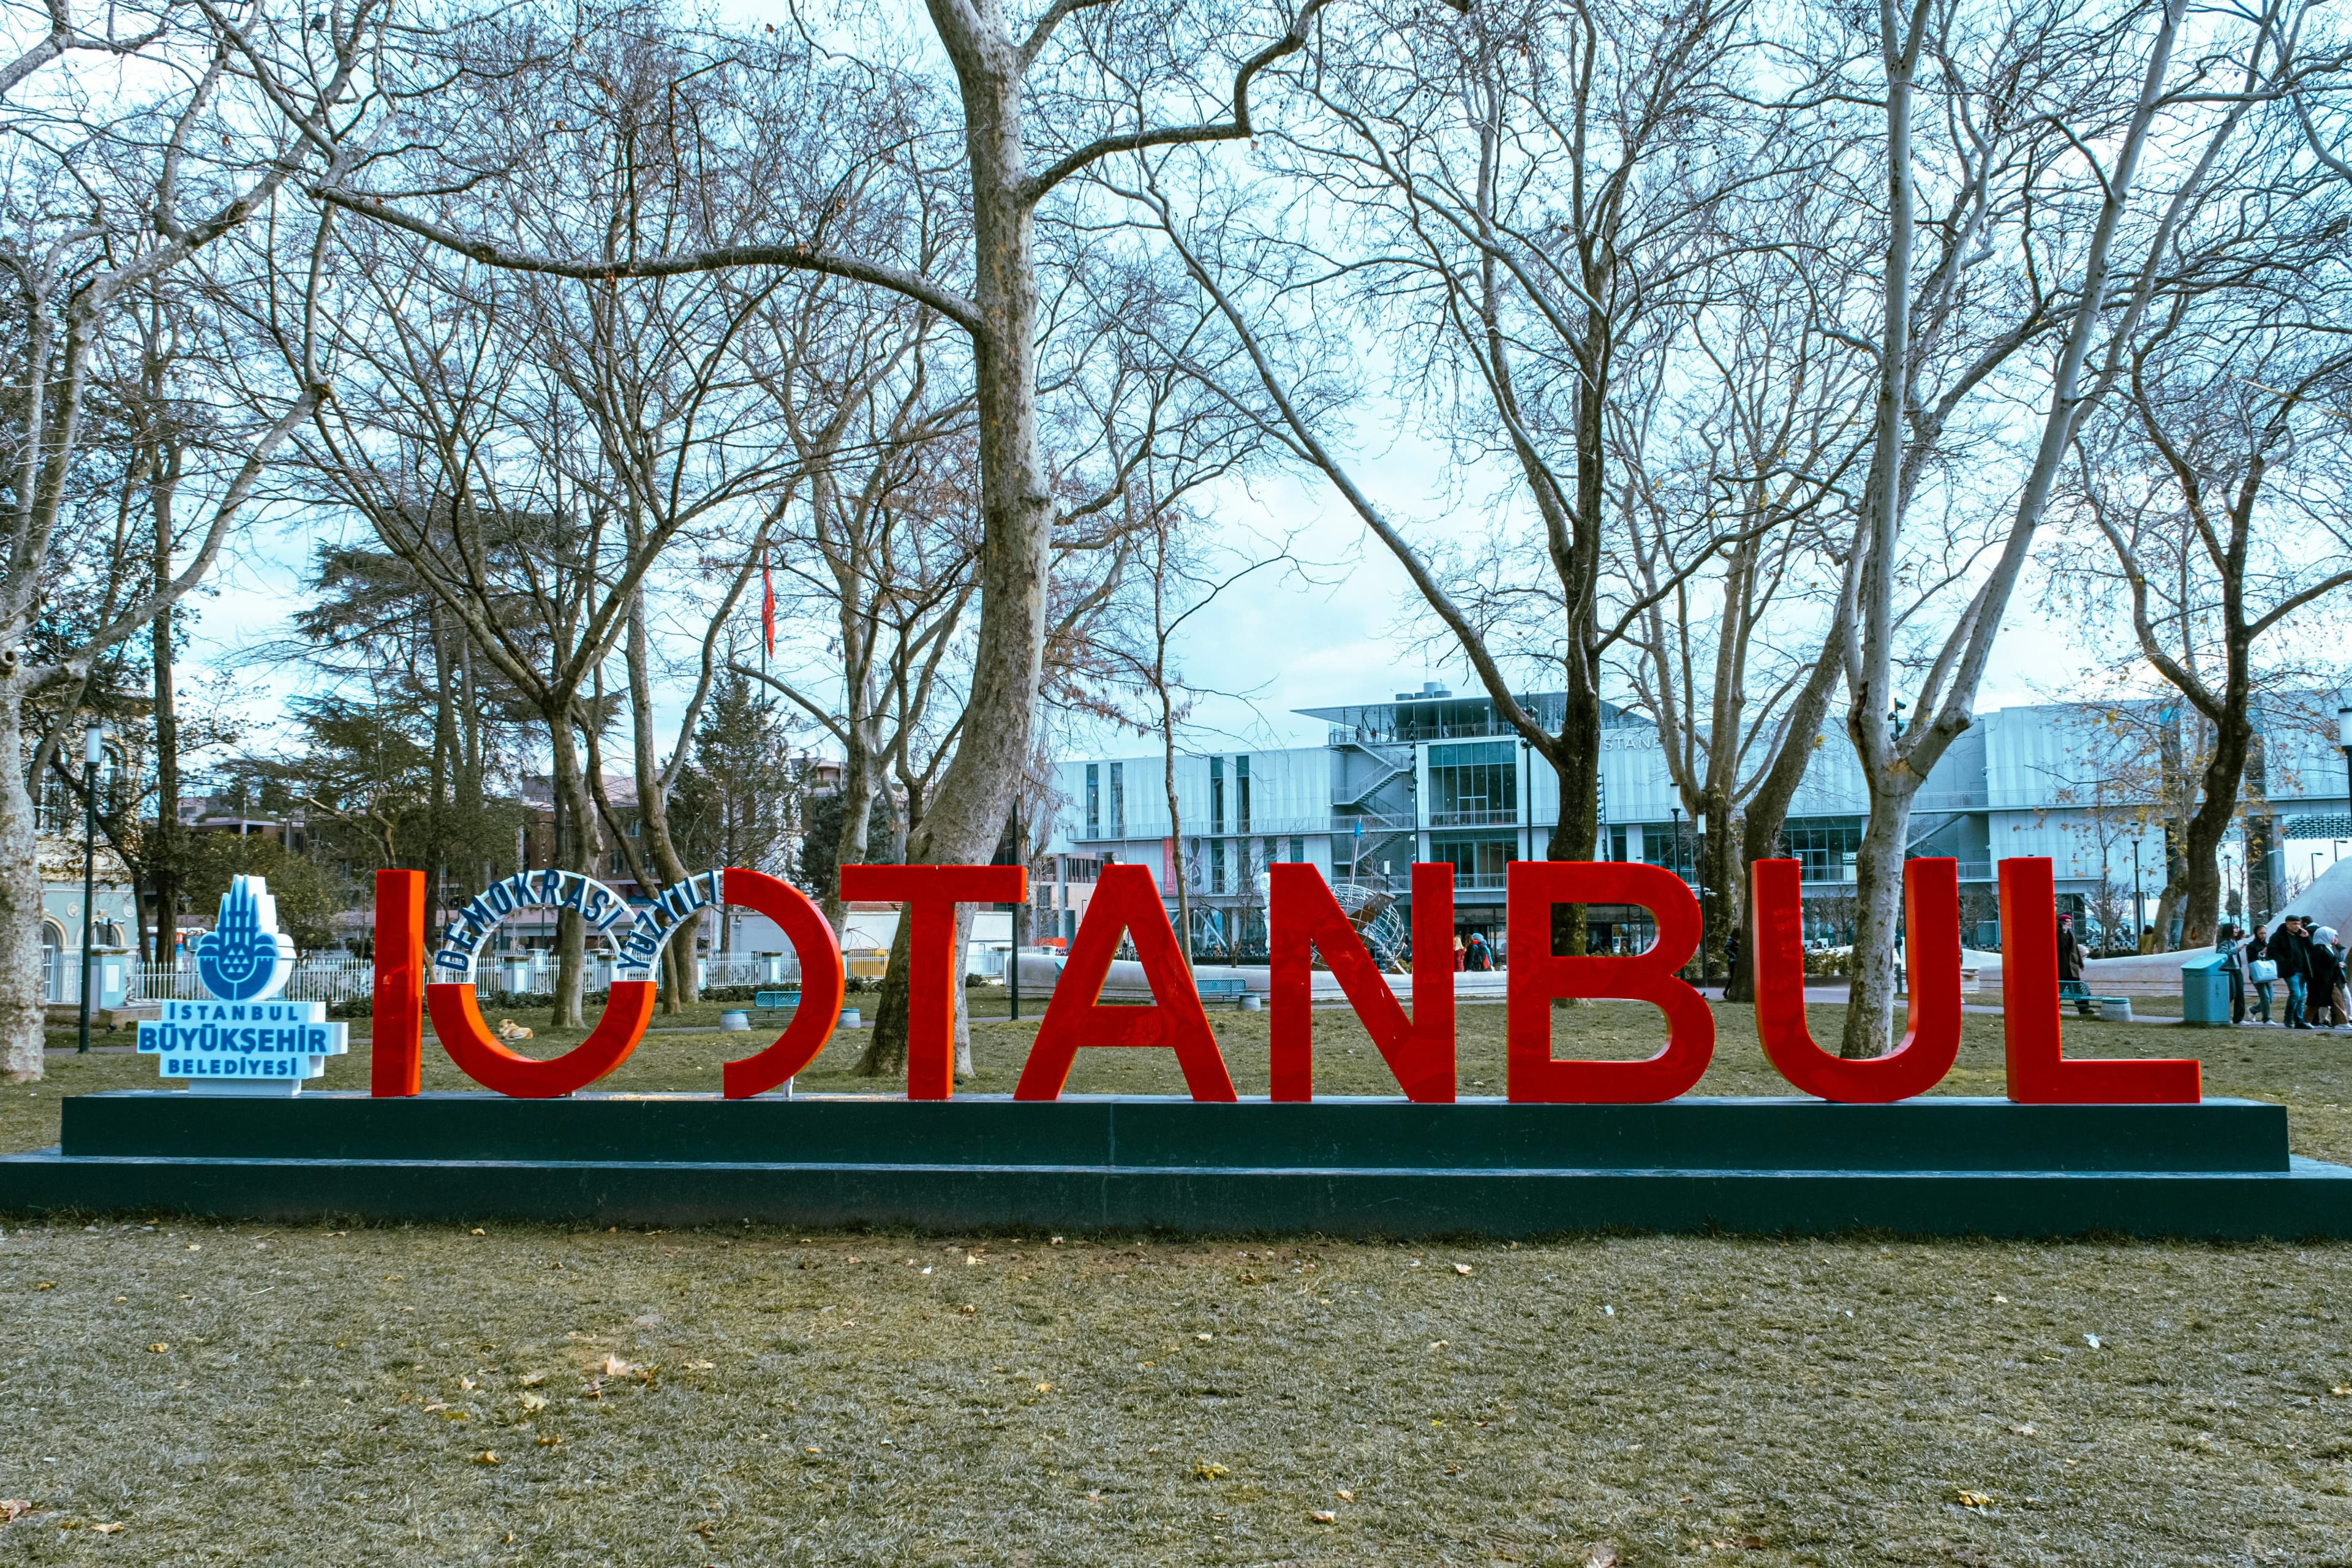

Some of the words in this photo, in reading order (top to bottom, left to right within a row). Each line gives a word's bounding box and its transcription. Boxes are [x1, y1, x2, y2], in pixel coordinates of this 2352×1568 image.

[170, 1002, 298, 1020] İSTANBUL
[139, 1023, 326, 1054] BÜYÜKŞEHİR
[168, 1057, 297, 1075] BELEDİYESİ
